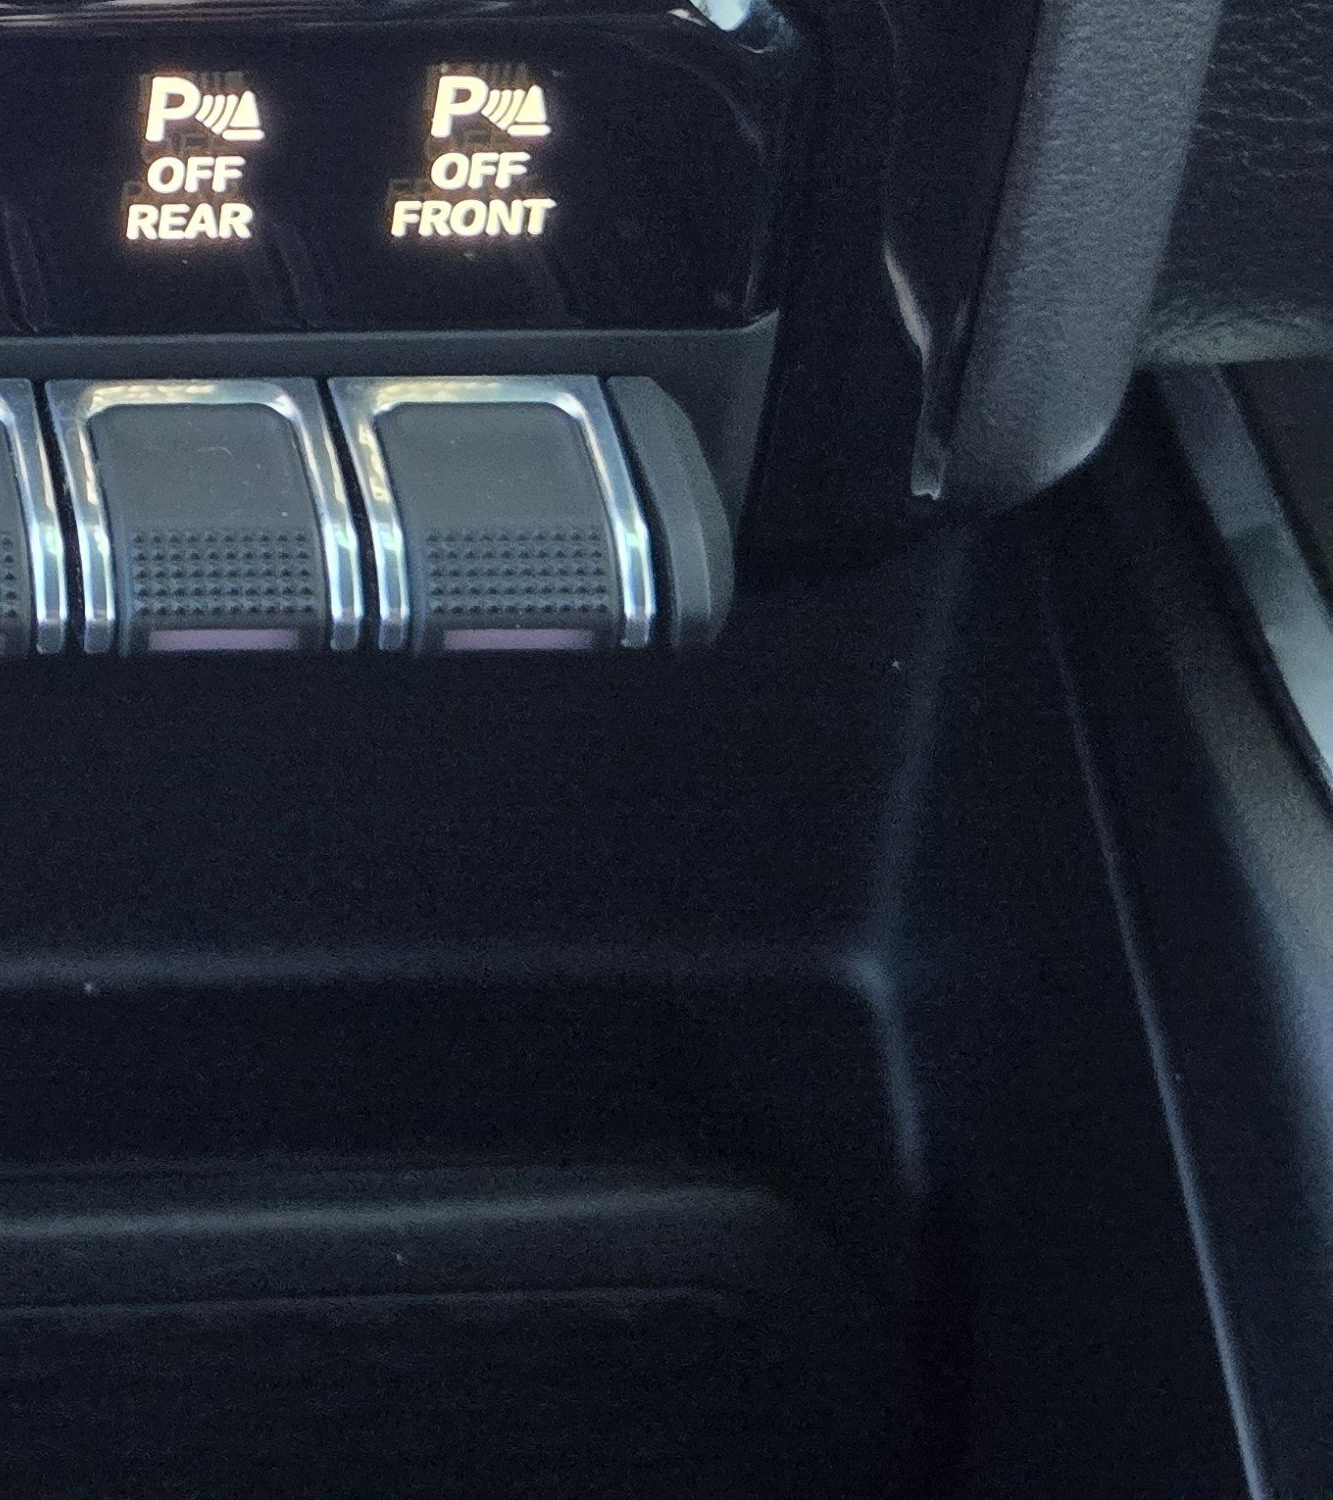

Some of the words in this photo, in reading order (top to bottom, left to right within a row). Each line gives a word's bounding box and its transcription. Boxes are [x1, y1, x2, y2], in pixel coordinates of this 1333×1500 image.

[148, 155, 244, 194] OFF
[431, 151, 529, 190] OFF
[125, 202, 251, 240] REAR
[391, 199, 557, 237] FRONT
